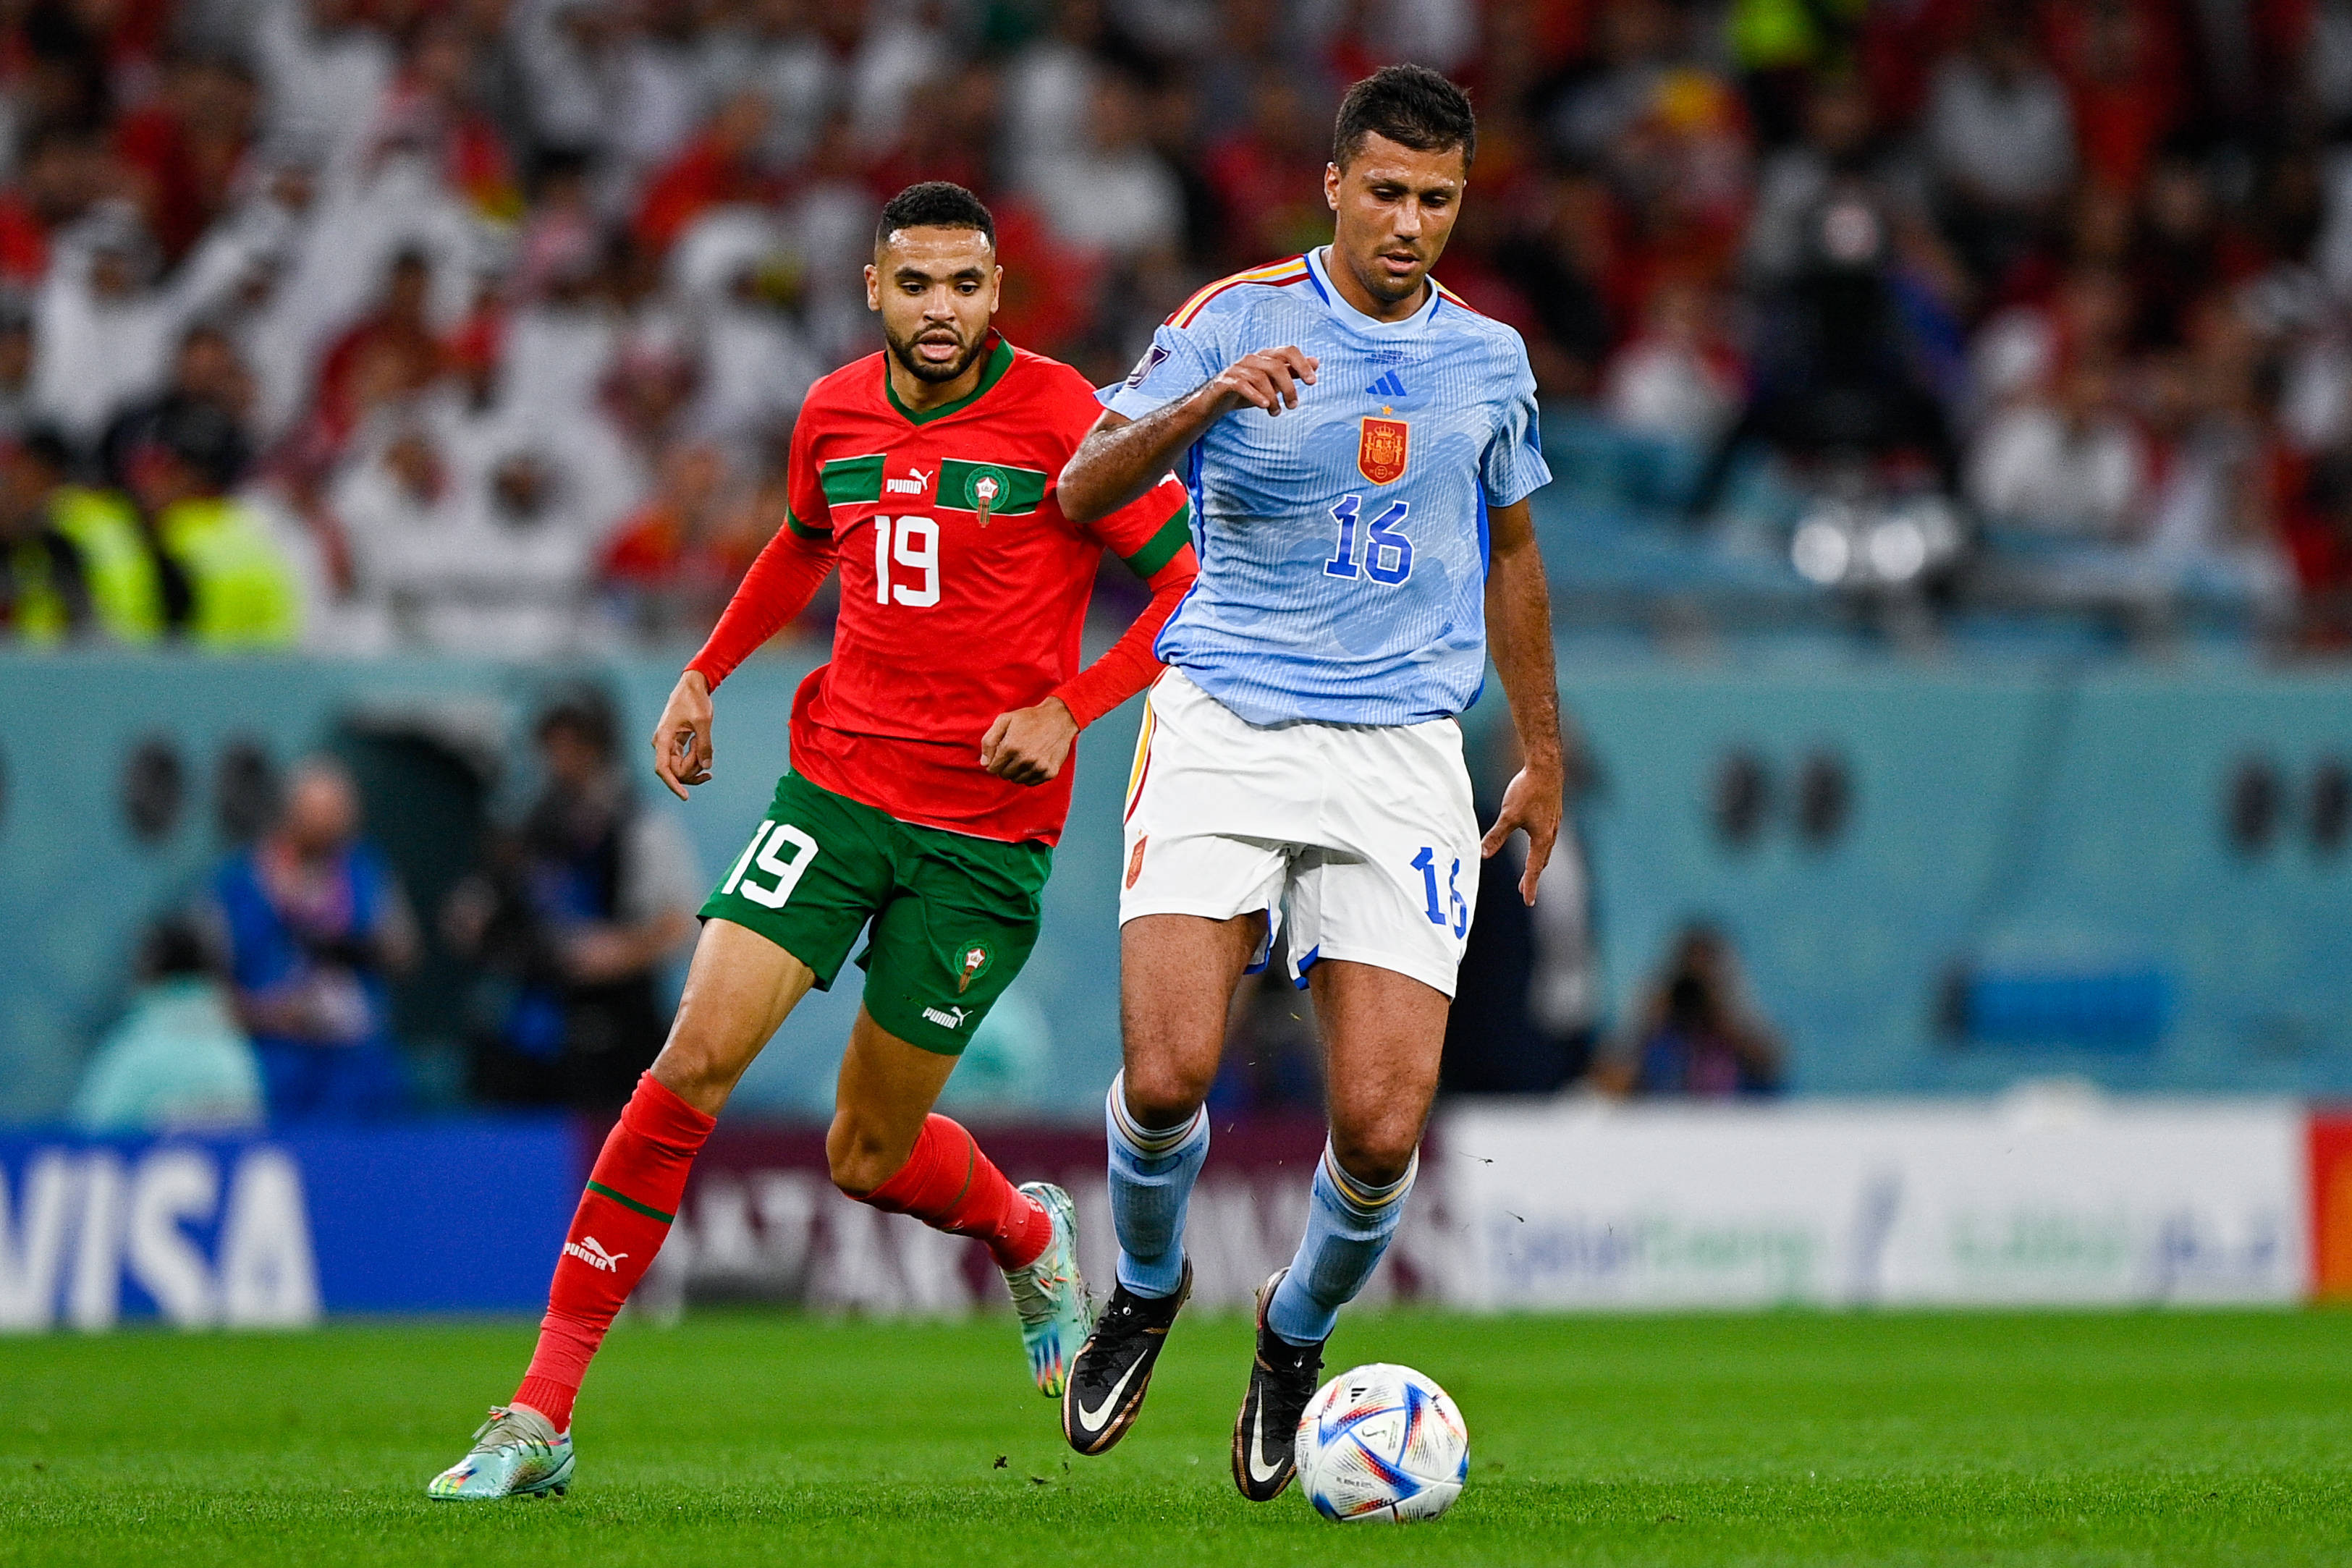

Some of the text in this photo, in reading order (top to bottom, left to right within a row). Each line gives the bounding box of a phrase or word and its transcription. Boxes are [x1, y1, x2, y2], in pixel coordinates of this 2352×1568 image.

[886, 478, 922, 495] PUMA
[874, 514, 940, 608] 19
[1323, 493, 1416, 588] 16
[721, 819, 819, 909] 19
[1409, 847, 1467, 940] 16
[921, 1007, 959, 1030] PUMA
[562, 1242, 609, 1271] PUMA
